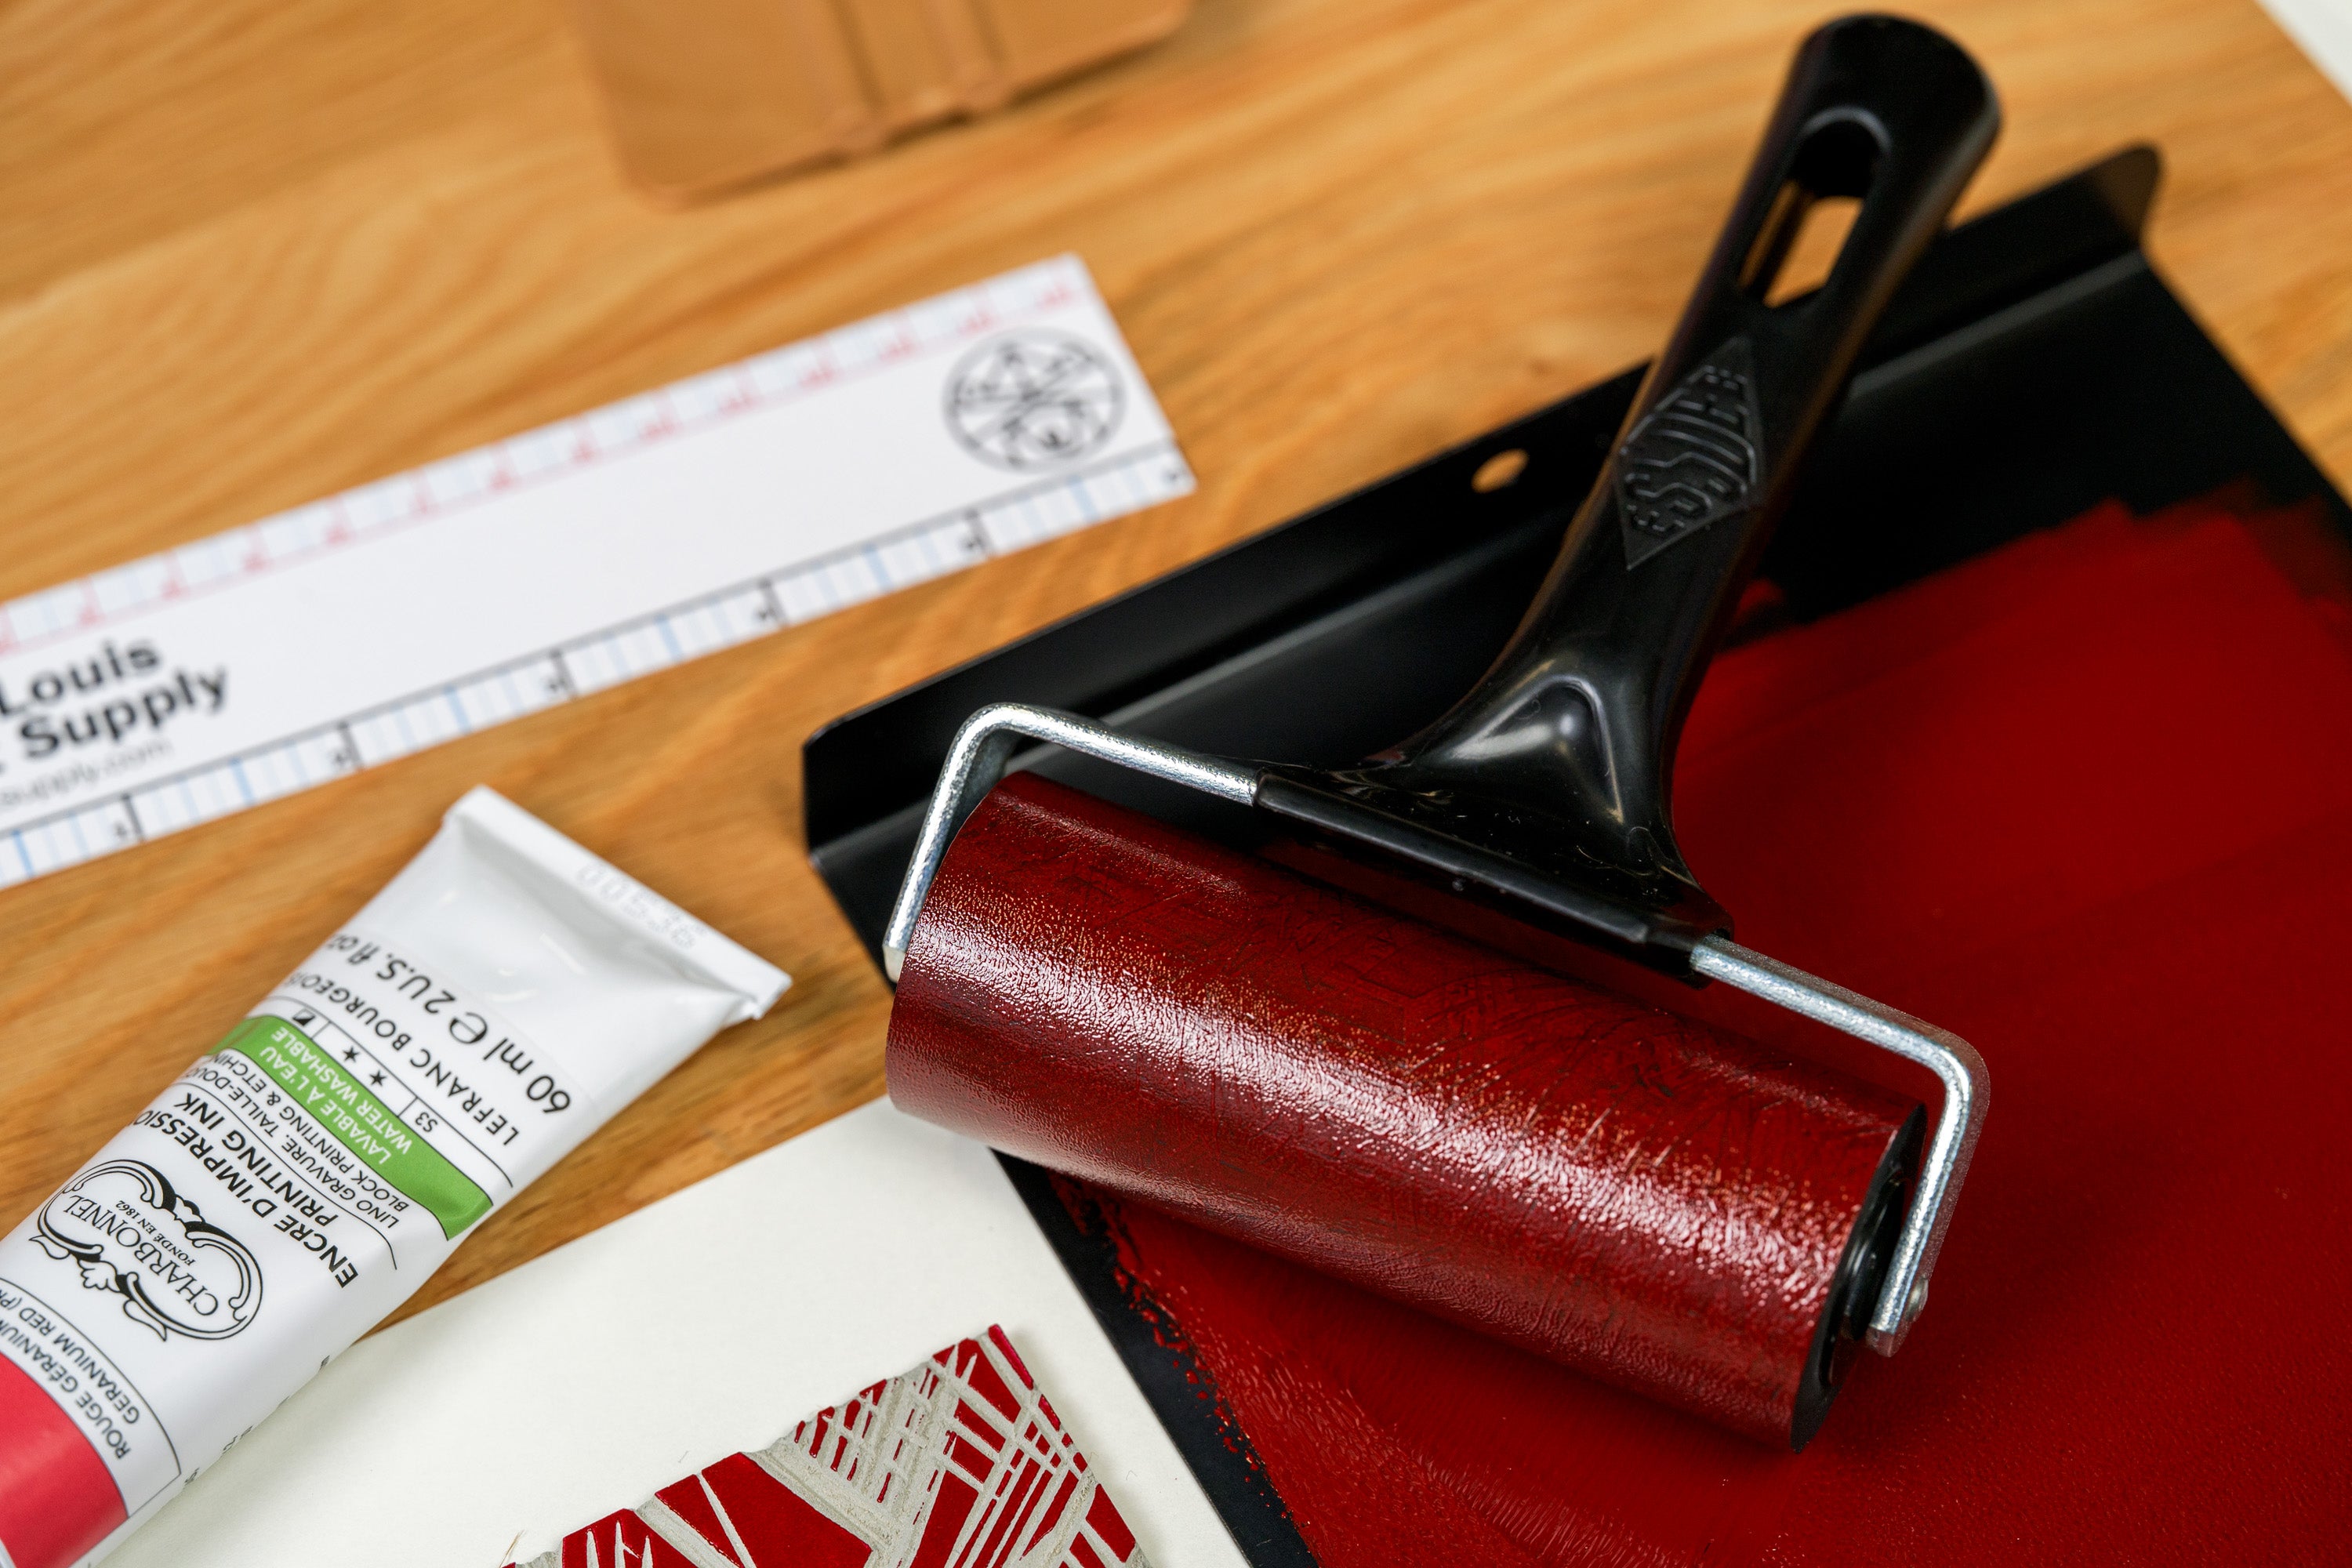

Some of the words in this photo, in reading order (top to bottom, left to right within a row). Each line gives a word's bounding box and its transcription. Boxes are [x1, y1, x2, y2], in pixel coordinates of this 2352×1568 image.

[20, 666, 227, 760] Supply
[376, 954, 431, 1000] U.S.
[424, 990, 456, 1014] 2
[209, 1052, 267, 1093] ETCHIN
[260, 1047, 310, 1091] L'EAU
[273, 1028, 358, 1105] WASHABLE
[483, 1039, 533, 1075] ml
[174, 1093, 225, 1131] INK
[267, 1091, 281, 1106] &
[307, 1086, 325, 1104] À
[410, 1049, 519, 1145] LEFRANC
[526, 1076, 571, 1113] 60
[279, 1106, 354, 1174] PRINTING
[321, 1099, 391, 1164] LAVABLE
[357, 1100, 412, 1154] WATER
[416, 1112, 437, 1132] S3
[133, 1110, 278, 1218] D'IMPRESSIO
[222, 1130, 339, 1226] PRINTING
[281, 1135, 355, 1200] GRAVURE.
[116, 1200, 140, 1219] 1862
[351, 1171, 409, 1212] BLOCK
[137, 1218, 157, 1234] EN
[357, 1200, 399, 1229] LINO
[64, 1196, 218, 1316] CHARBONNEL
[153, 1233, 195, 1265] FONDÉ
[274, 1214, 358, 1288] ENCRE
[19, 1308, 55, 1336] RED
[53, 1334, 140, 1425] GERANIUM
[76, 1392, 131, 1460] ROUGE
